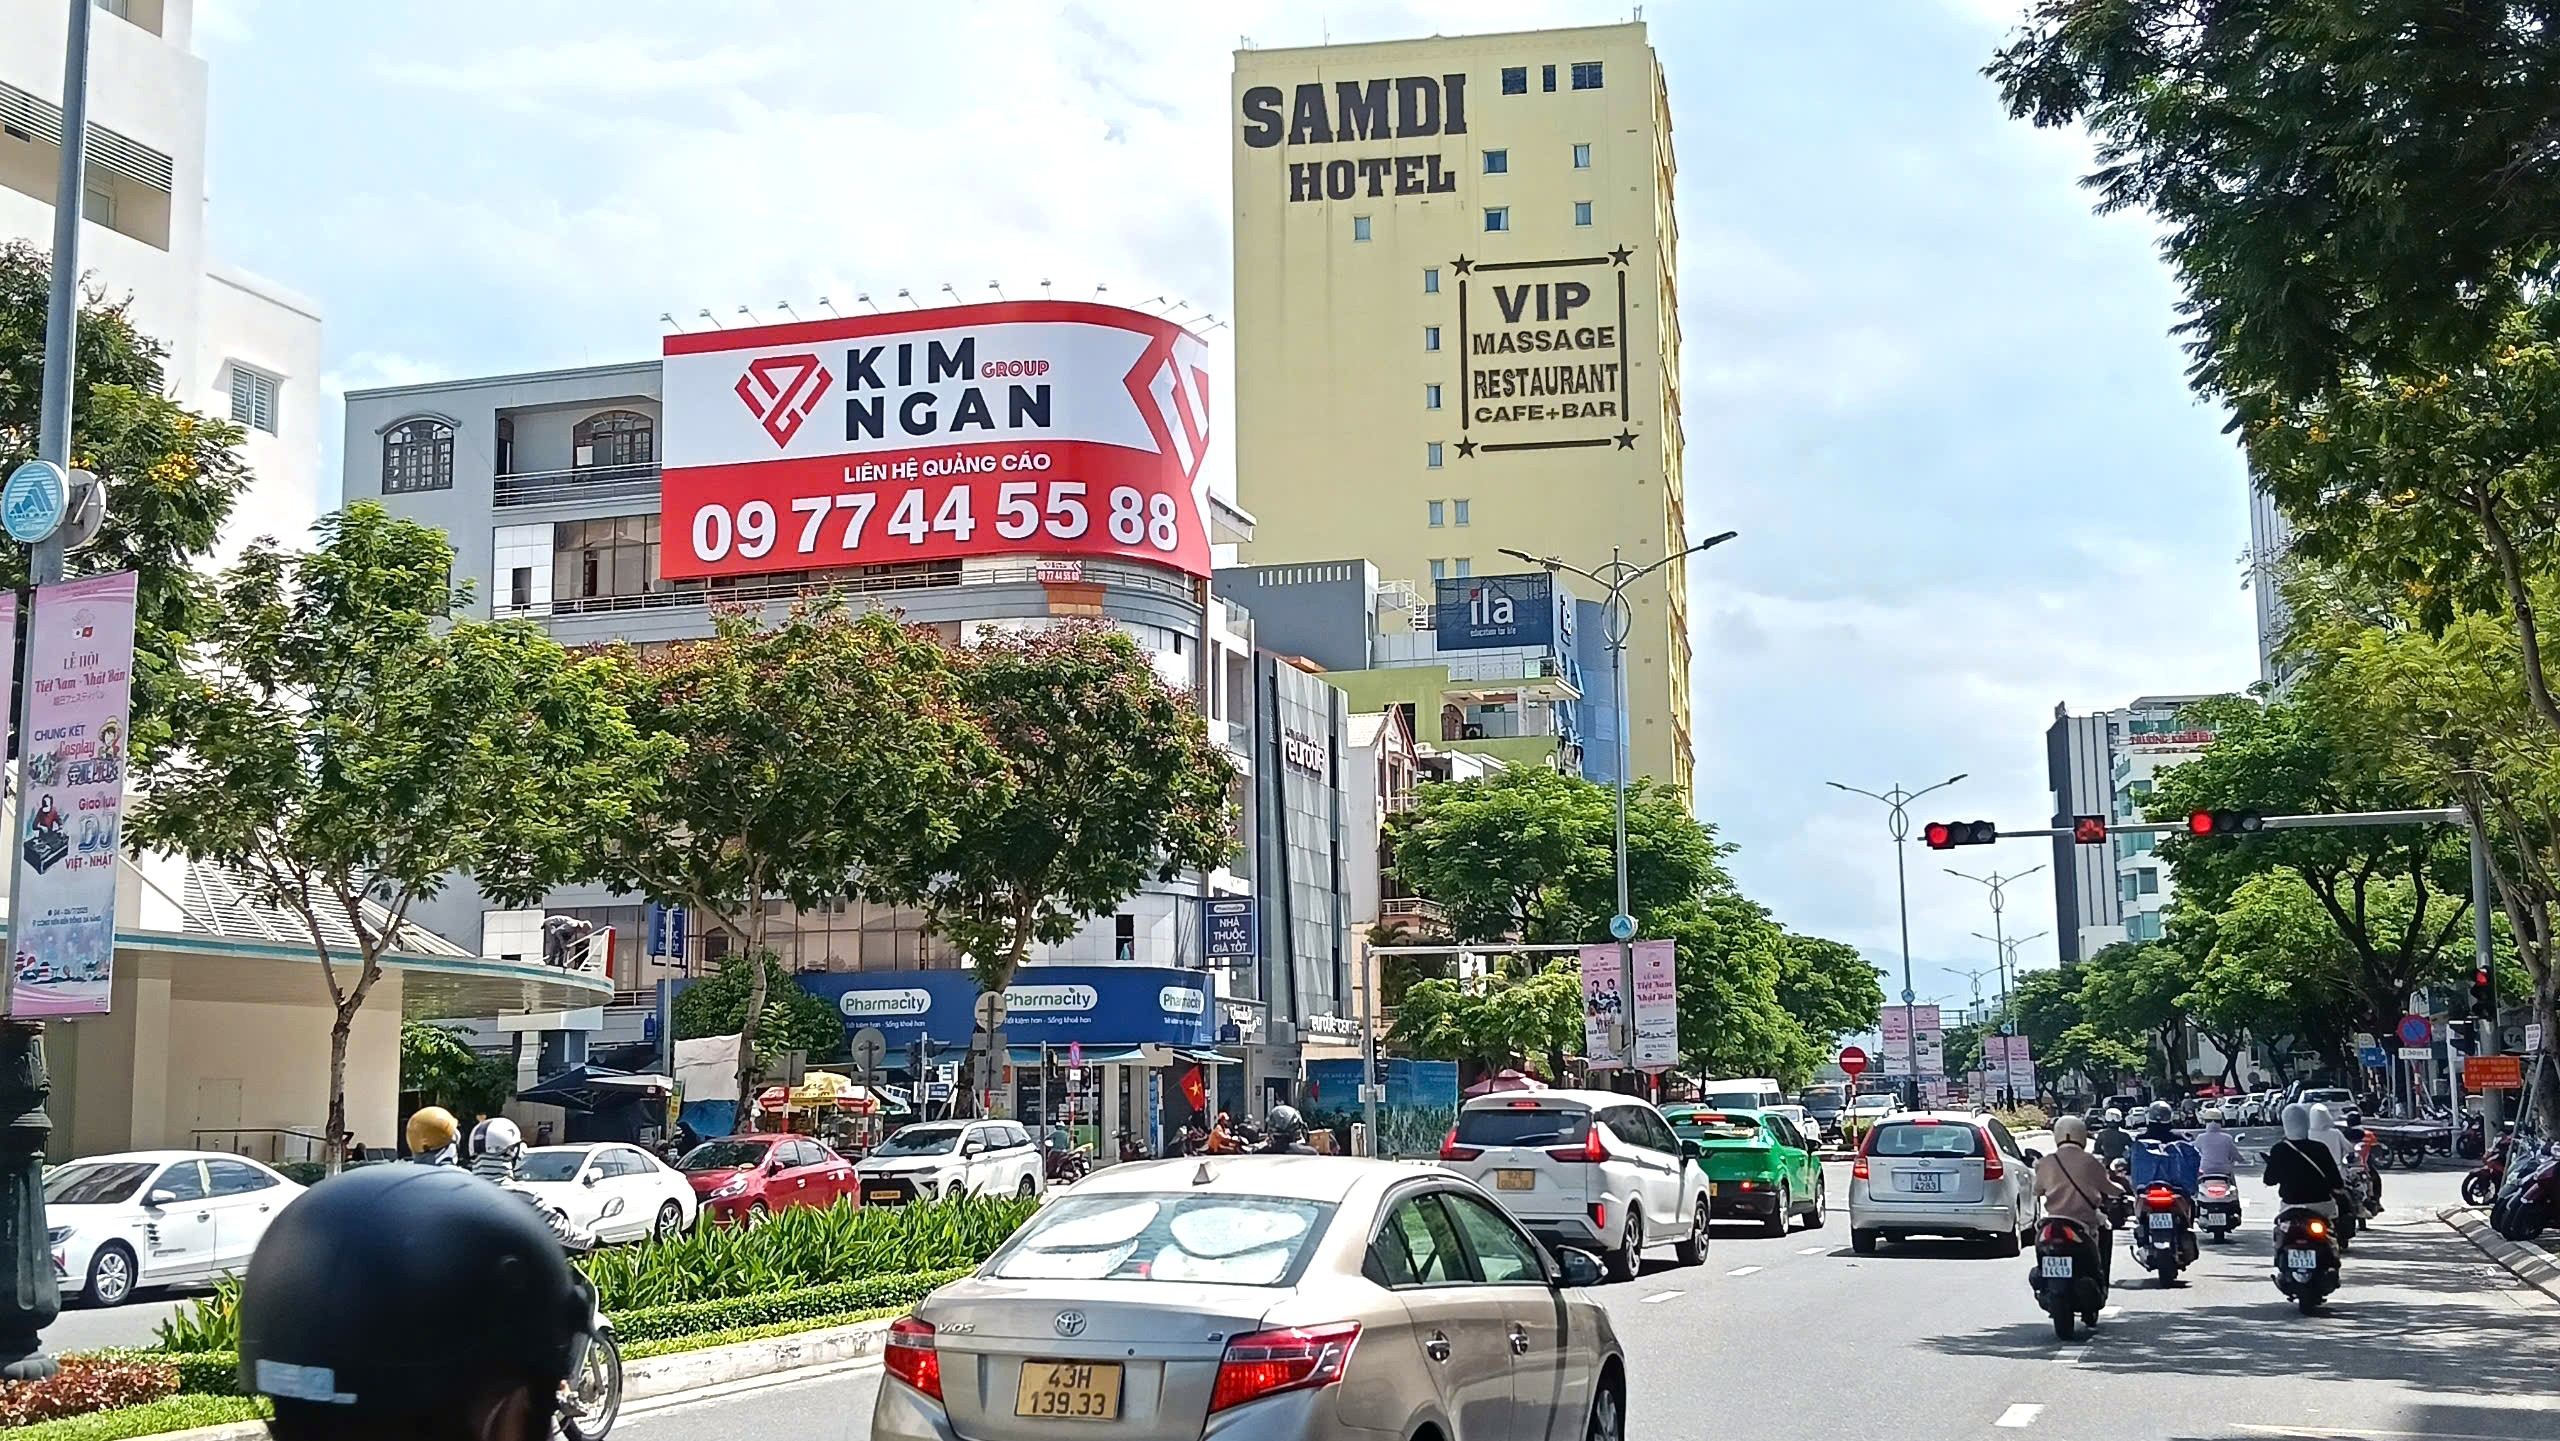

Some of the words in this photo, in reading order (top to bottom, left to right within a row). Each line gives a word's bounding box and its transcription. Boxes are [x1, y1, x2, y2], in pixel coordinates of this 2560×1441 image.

[1242, 73, 1467, 149] SAMDI
[1289, 154, 1456, 202] HOTEL
[1493, 282, 1591, 324] VIP
[1472, 326, 1616, 355] MASSAGE
[847, 337, 978, 392] KIM
[981, 359, 1050, 378] GROUP
[1473, 363, 1619, 400] RESTAURANT
[846, 384, 1052, 441] NGAN
[1474, 401, 1617, 423] CAFE+BAR
[844, 463, 888, 483] LIÊN
[891, 457, 918, 482] HỆ
[922, 451, 997, 477] QUẢNG
[1001, 450, 1051, 471] CÁO
[691, 500, 777, 561] 09
[791, 492, 876, 553] 77
[887, 484, 976, 543] 44
[994, 481, 1089, 539] 55
[1108, 486, 1178, 552] 88
[1470, 588, 1514, 625] ila
[34, 728, 66, 742] CHUNG
[69, 724, 86, 738] KẾT
[59, 740, 96, 760] Cosplay
[78, 797, 100, 812] Giao
[78, 812, 117, 854] DJ
[65, 857, 83, 872] VIỆT
[90, 853, 113, 870] NHẬT
[1213, 927, 1246, 941] THUỐC
[1219, 916, 1240, 928] NHÀ
[1212, 942, 1229, 953] GIÁ
[1230, 940, 1247, 952] TỐT
[846, 991, 925, 1012] Pharmacity
[1004, 987, 1091, 1008] Pharmacity
[1914, 1182, 1936, 1190] 4283
[1048, 1363, 1092, 1389] 43H
[1031, 1390, 1106, 1416] 139.33
